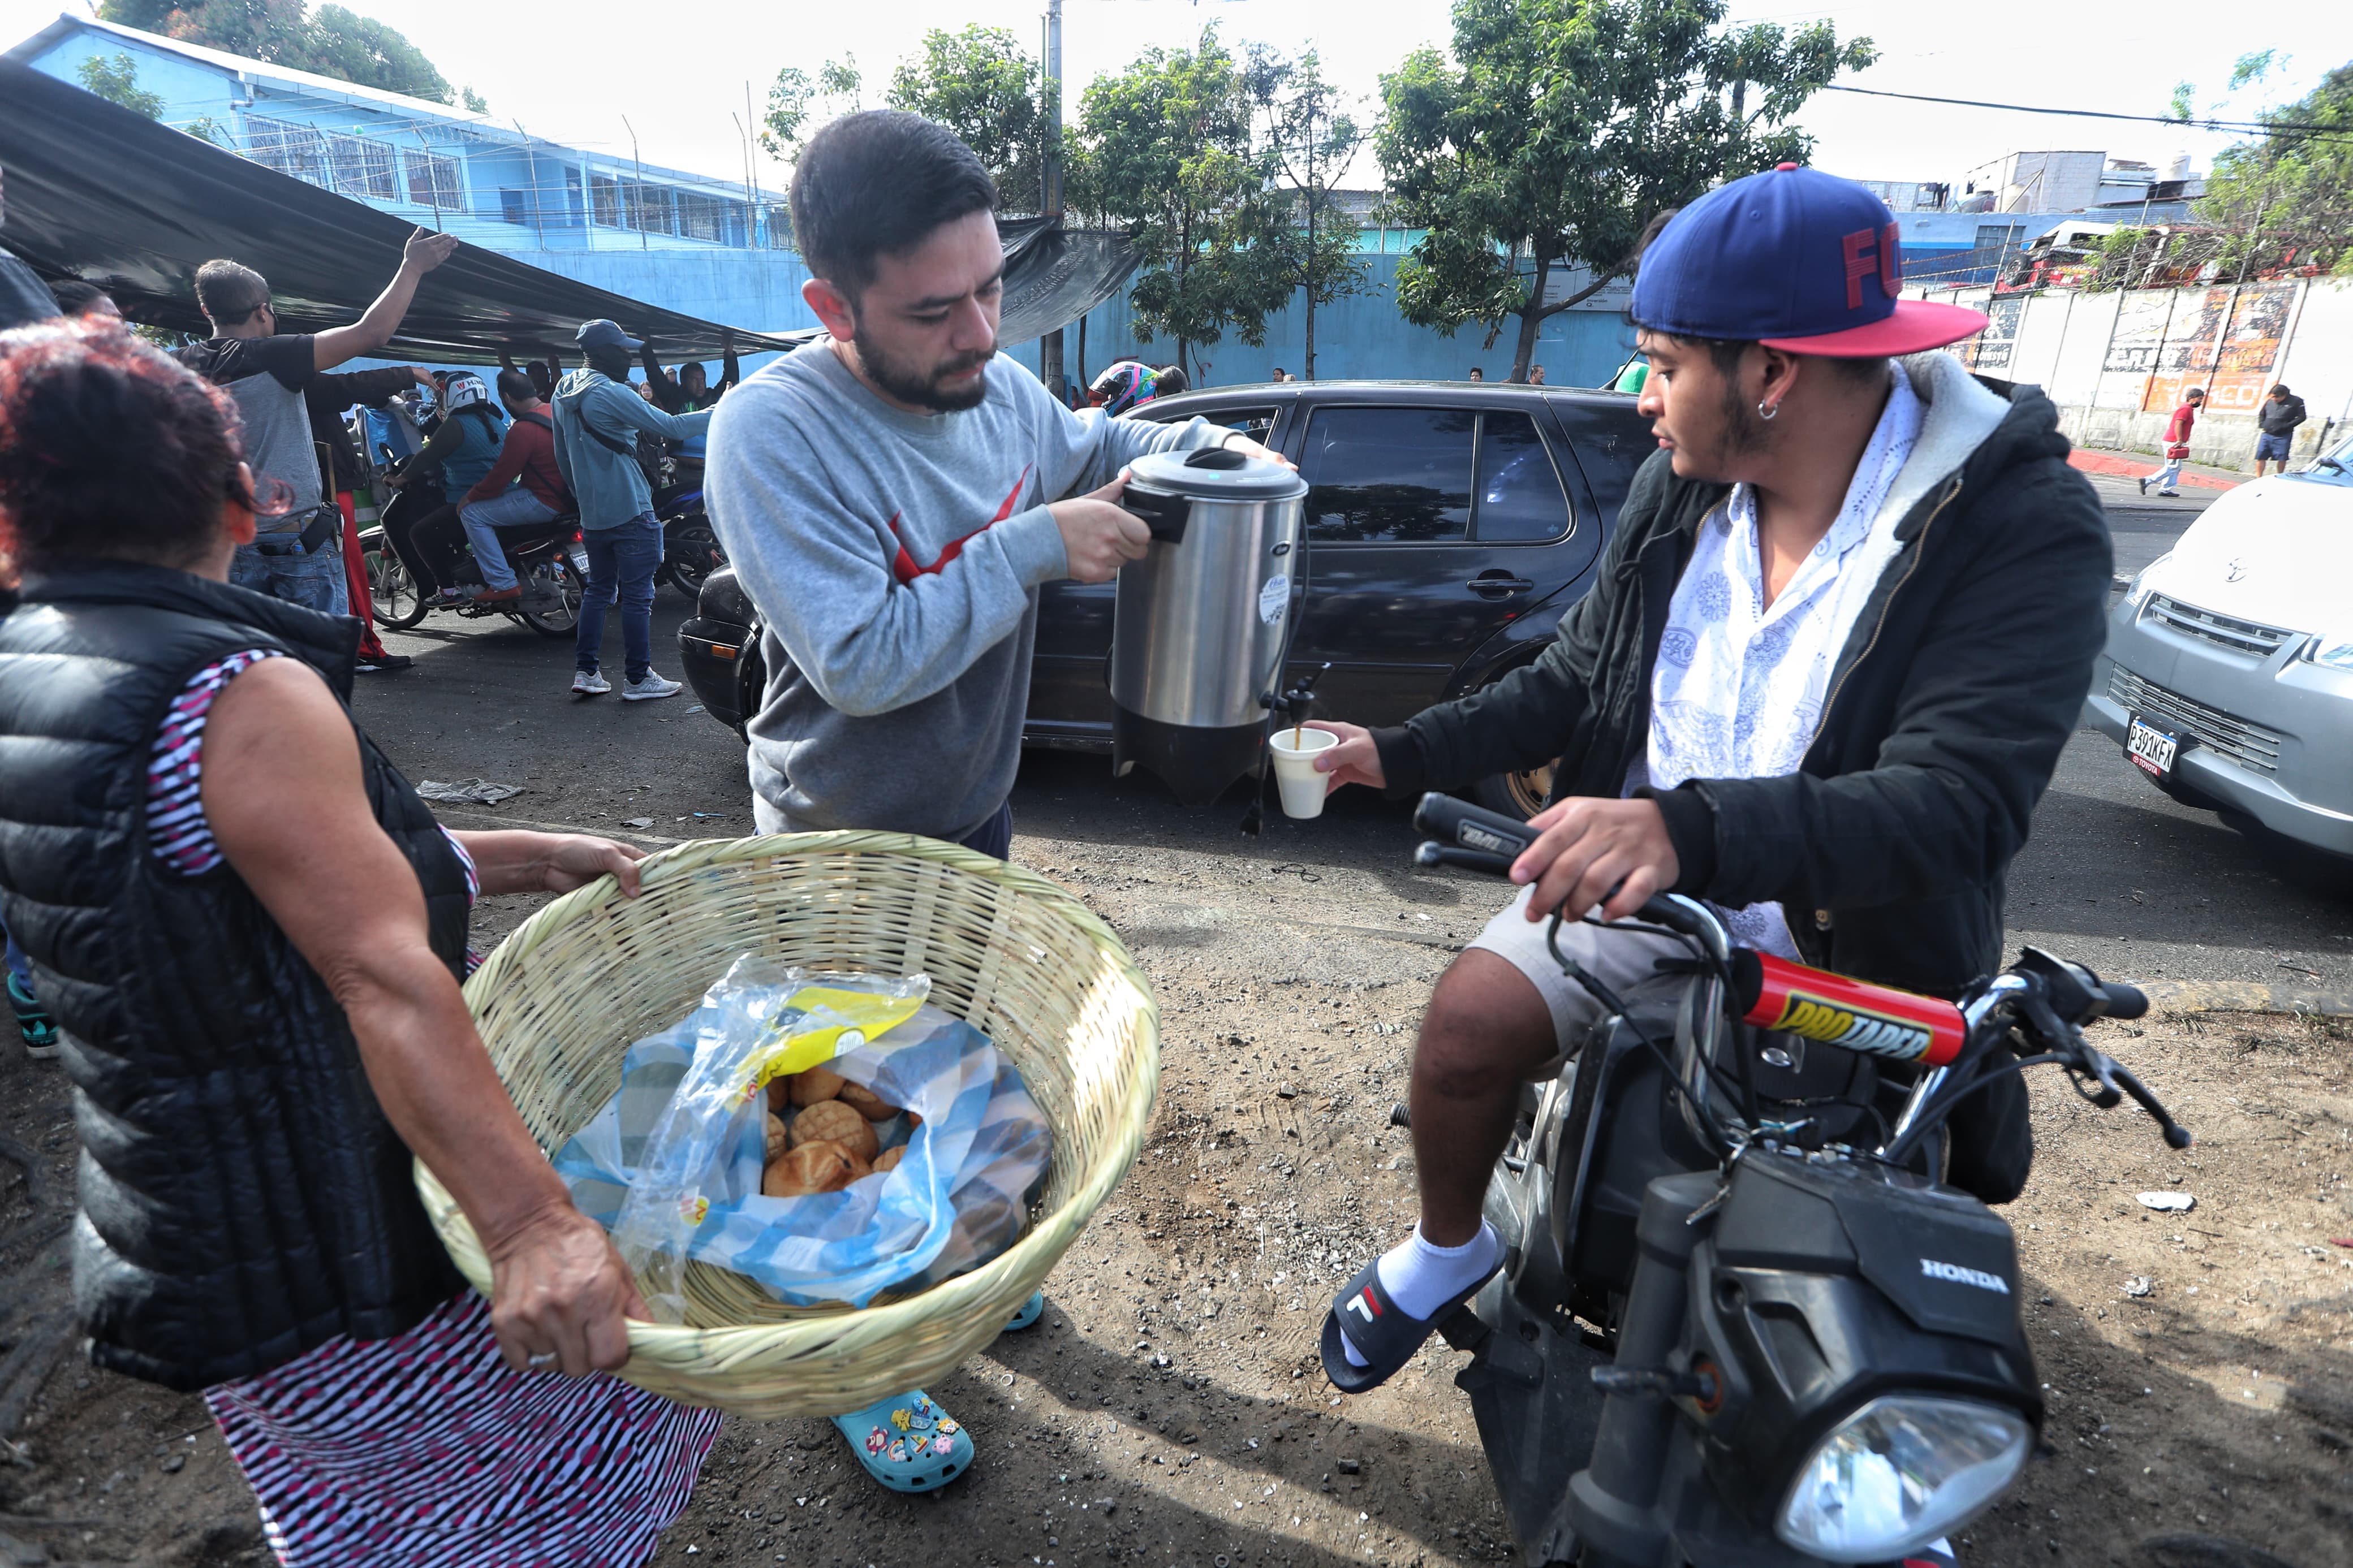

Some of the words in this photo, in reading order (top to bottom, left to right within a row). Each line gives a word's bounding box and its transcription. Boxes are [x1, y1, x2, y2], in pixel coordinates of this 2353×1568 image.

[2129, 725, 2174, 768] P391KFX
[2139, 758, 2158, 775] TOYOTA
[1920, 1258, 2010, 1294] HONDA
